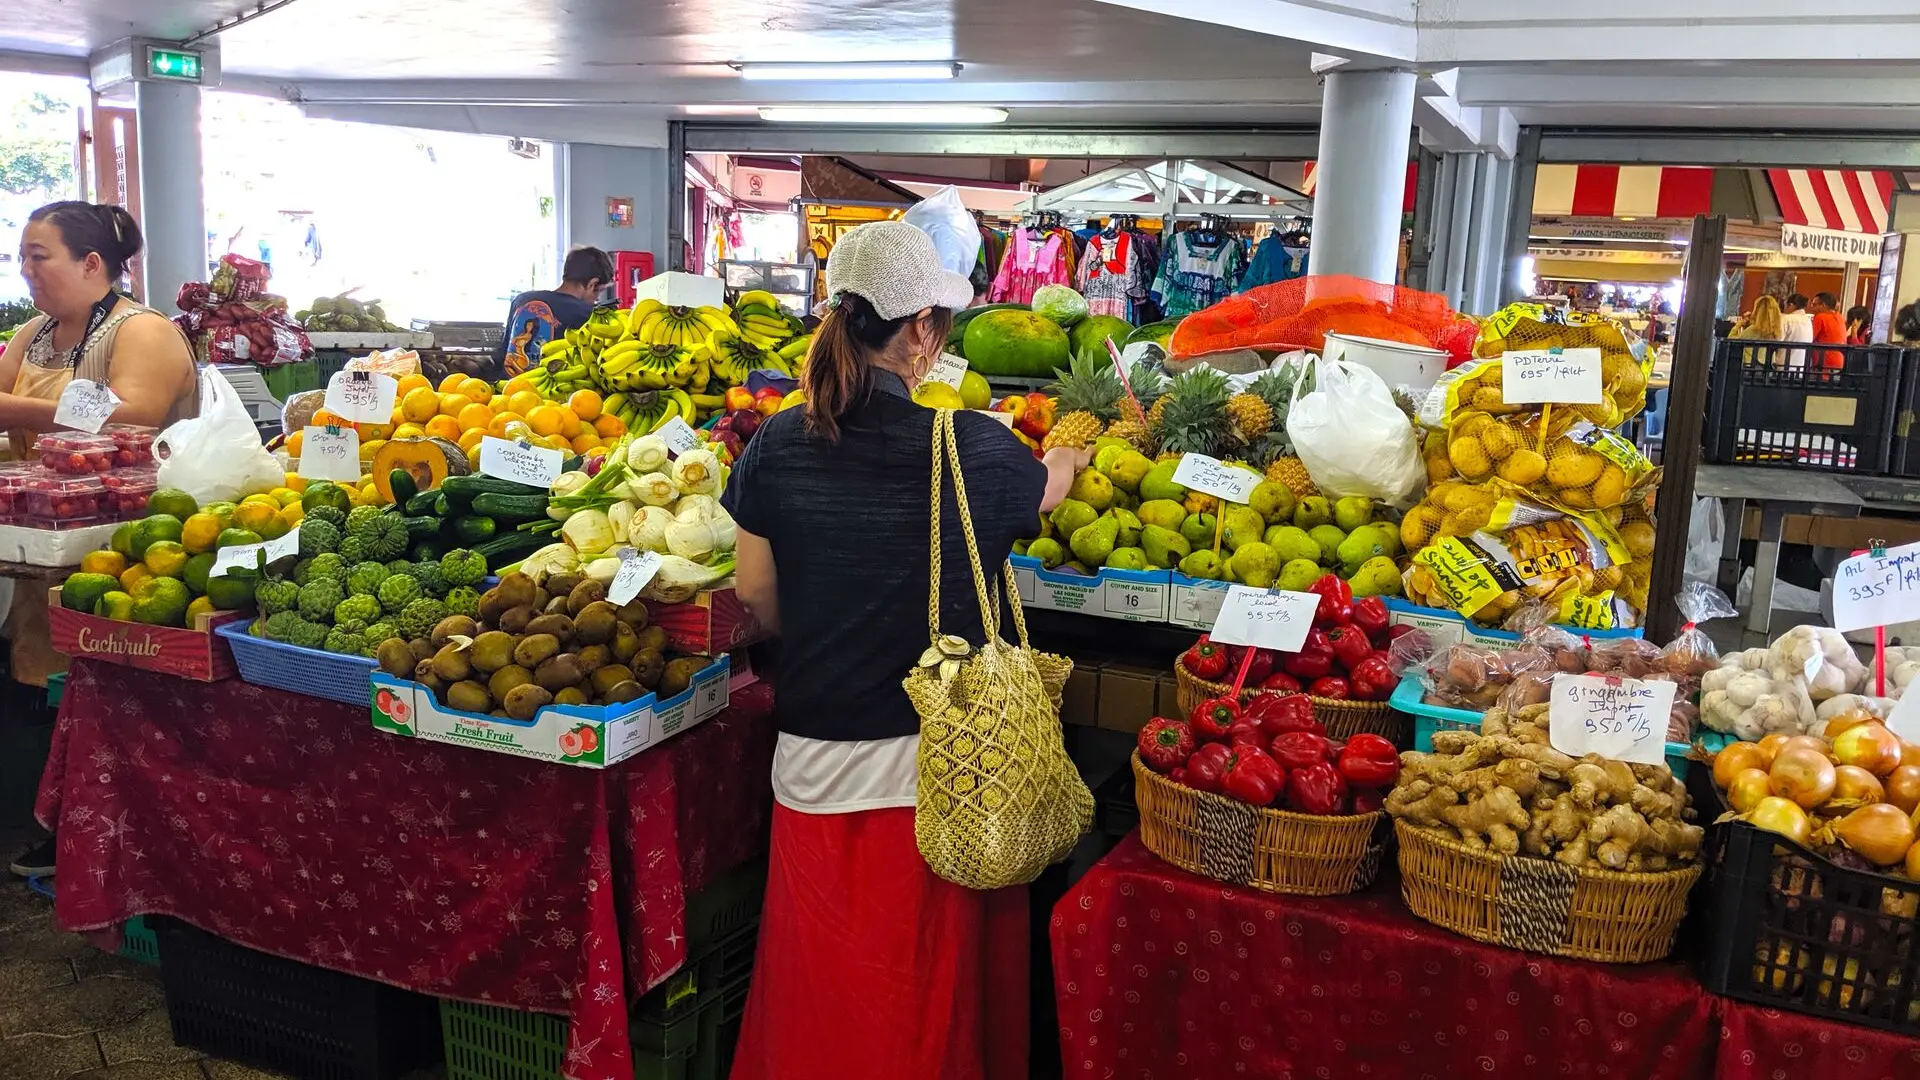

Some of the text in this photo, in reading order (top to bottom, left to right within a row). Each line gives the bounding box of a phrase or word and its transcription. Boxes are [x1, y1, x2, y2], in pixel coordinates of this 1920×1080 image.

[1782, 226, 1798, 246] LA
[1801, 231, 1848, 254] BUVETTE
[1850, 237, 1867, 255] DU
[1110, 582, 1130, 590] COUNT
[1124, 593, 1139, 607] 16
[78, 626, 162, 657] Cachirulo
[455, 723, 514, 743] Fresh Fruit
